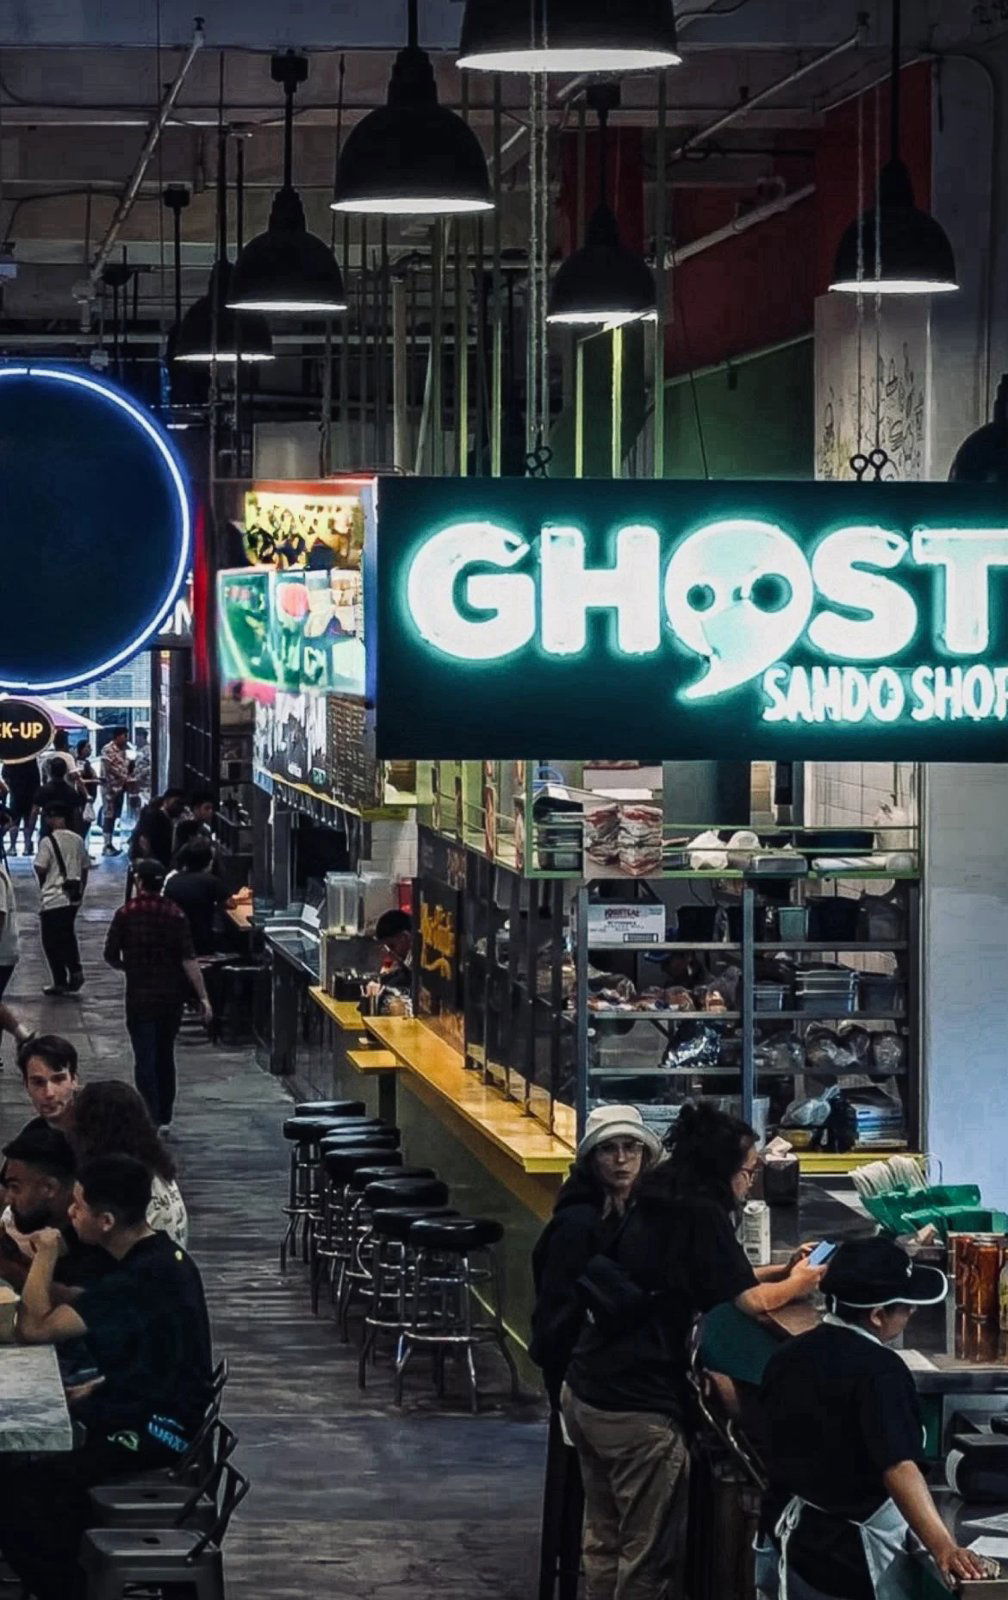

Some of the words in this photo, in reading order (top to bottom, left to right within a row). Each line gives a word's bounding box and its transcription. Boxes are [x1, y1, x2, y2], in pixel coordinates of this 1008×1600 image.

[407, 519, 1008, 700] GHOST
[763, 666, 904, 722] SANDO
[0, 722, 44, 739] K-UP
